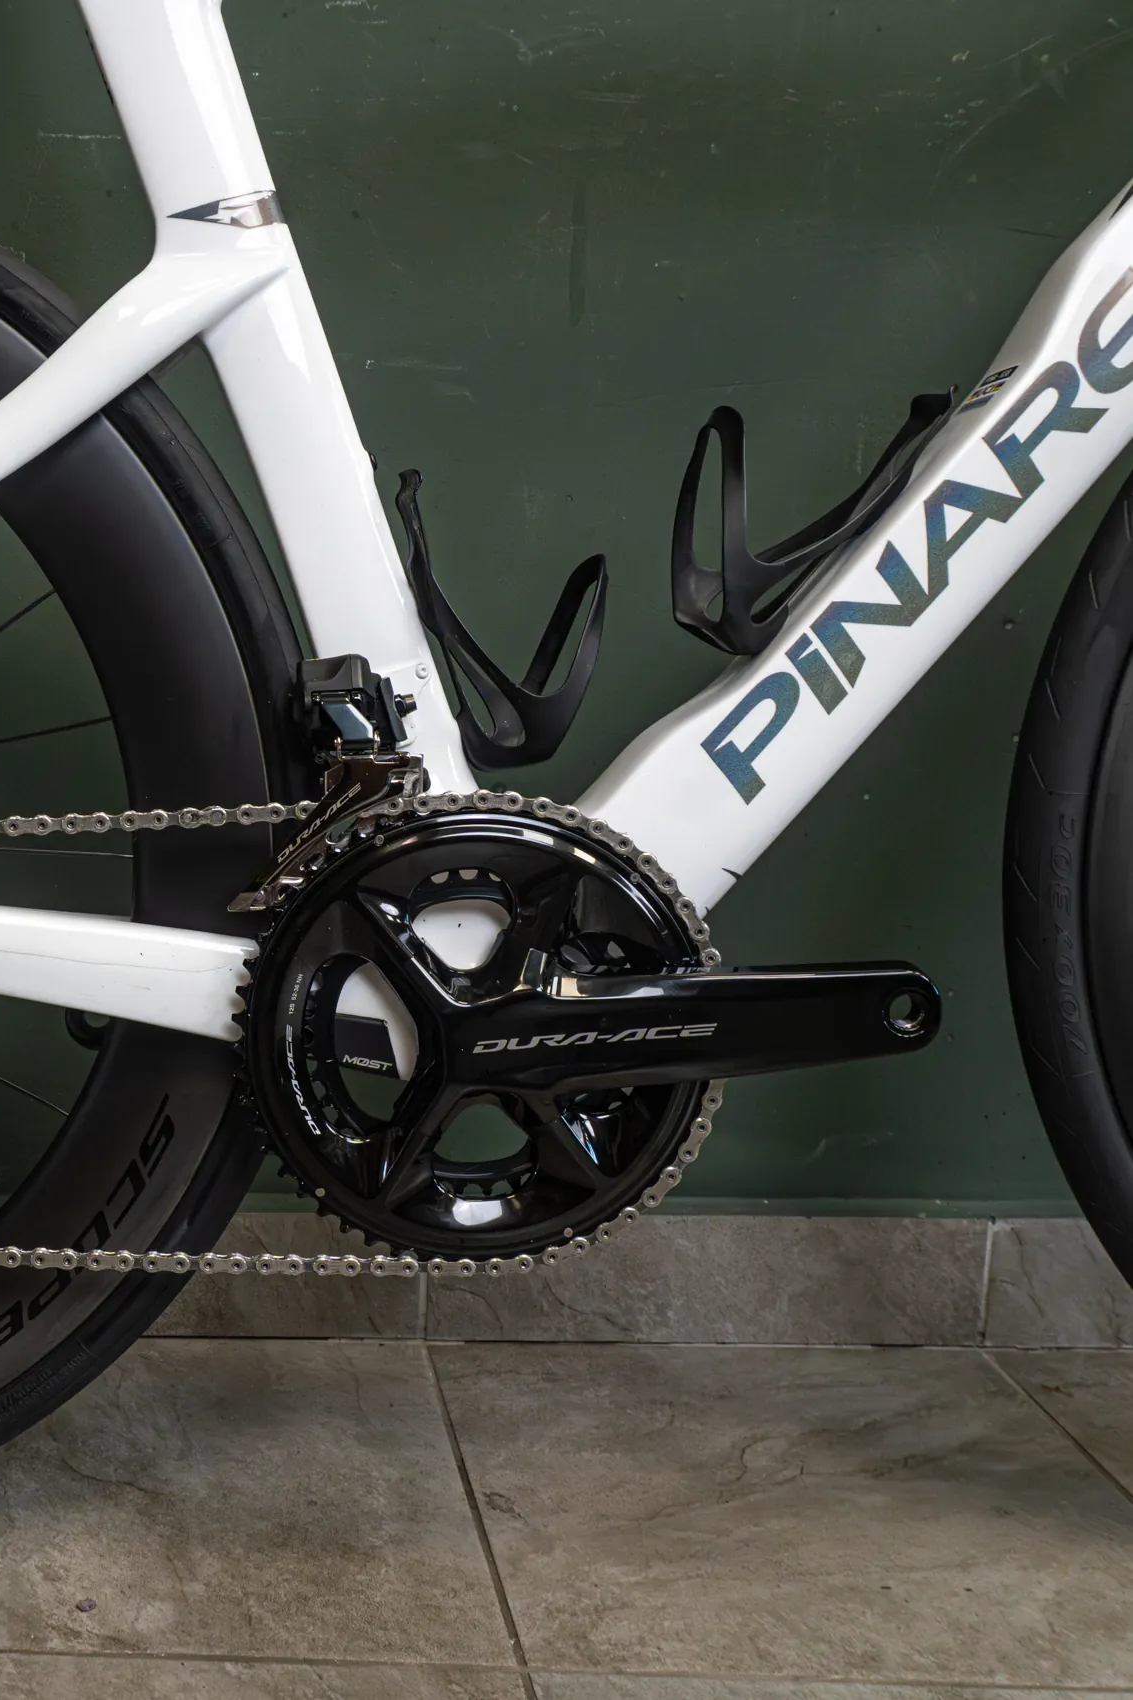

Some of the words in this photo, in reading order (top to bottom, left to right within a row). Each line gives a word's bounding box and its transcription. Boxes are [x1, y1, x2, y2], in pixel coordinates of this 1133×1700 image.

[277, 782, 362, 864] DURA-ACE
[285, 1023, 322, 1135] DURA-ACE
[472, 1022, 718, 1054] DURA-ACE
